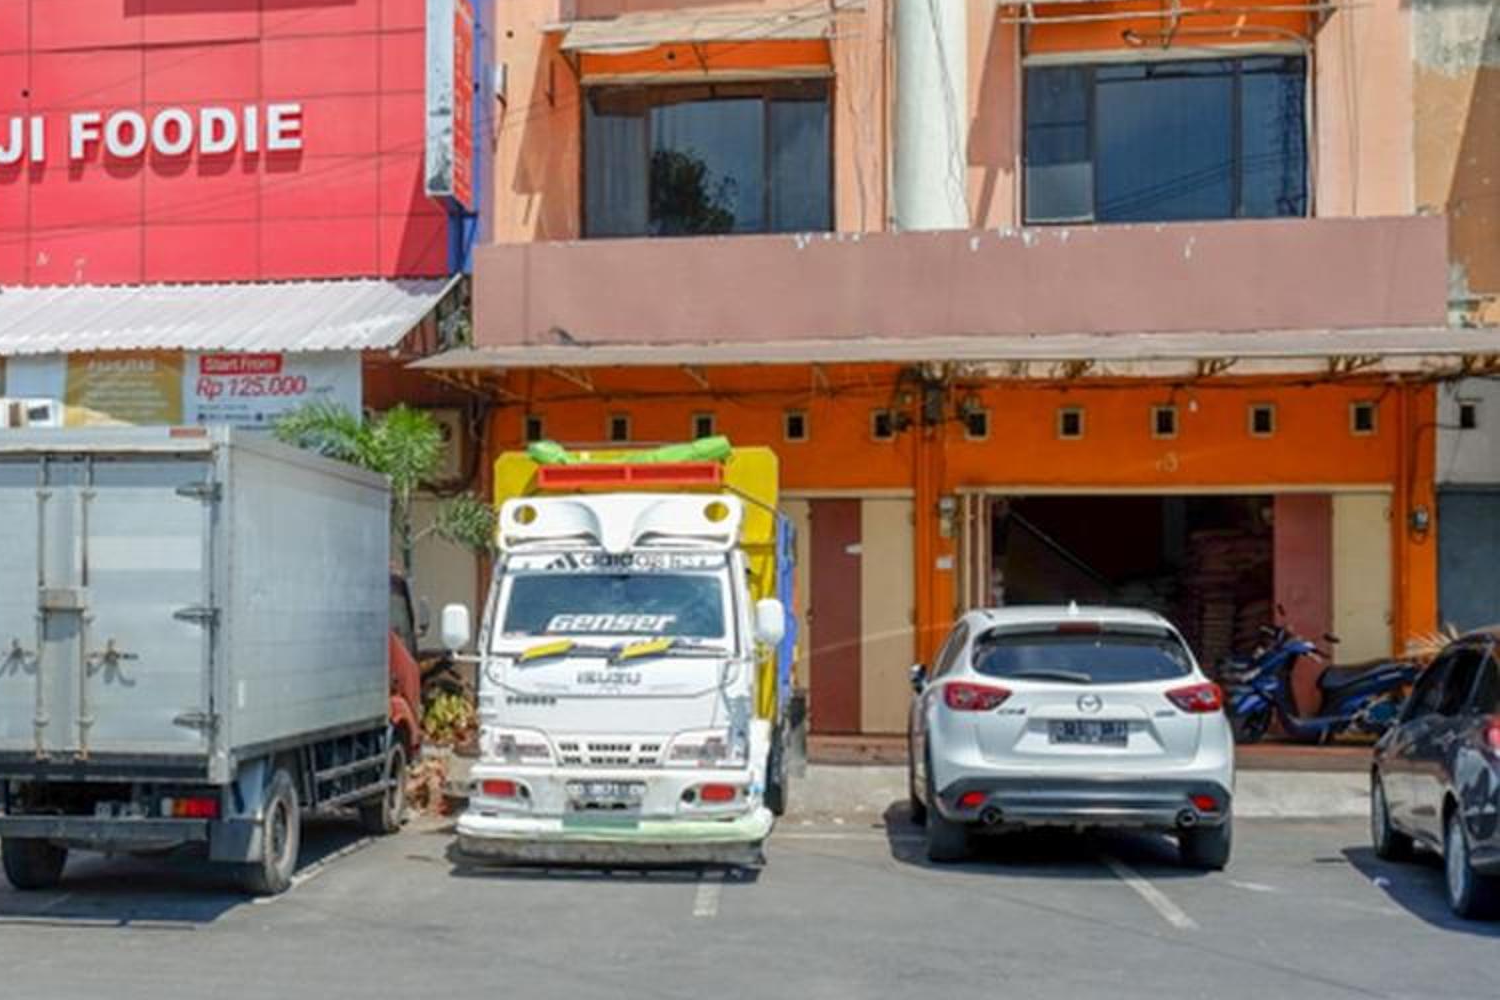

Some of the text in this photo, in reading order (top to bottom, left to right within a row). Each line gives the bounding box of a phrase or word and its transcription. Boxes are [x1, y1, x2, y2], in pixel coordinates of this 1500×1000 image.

[69, 102, 302, 160] FOODIE
[197, 377, 223, 399] Rp
[577, 672, 642, 686] ISUZU
